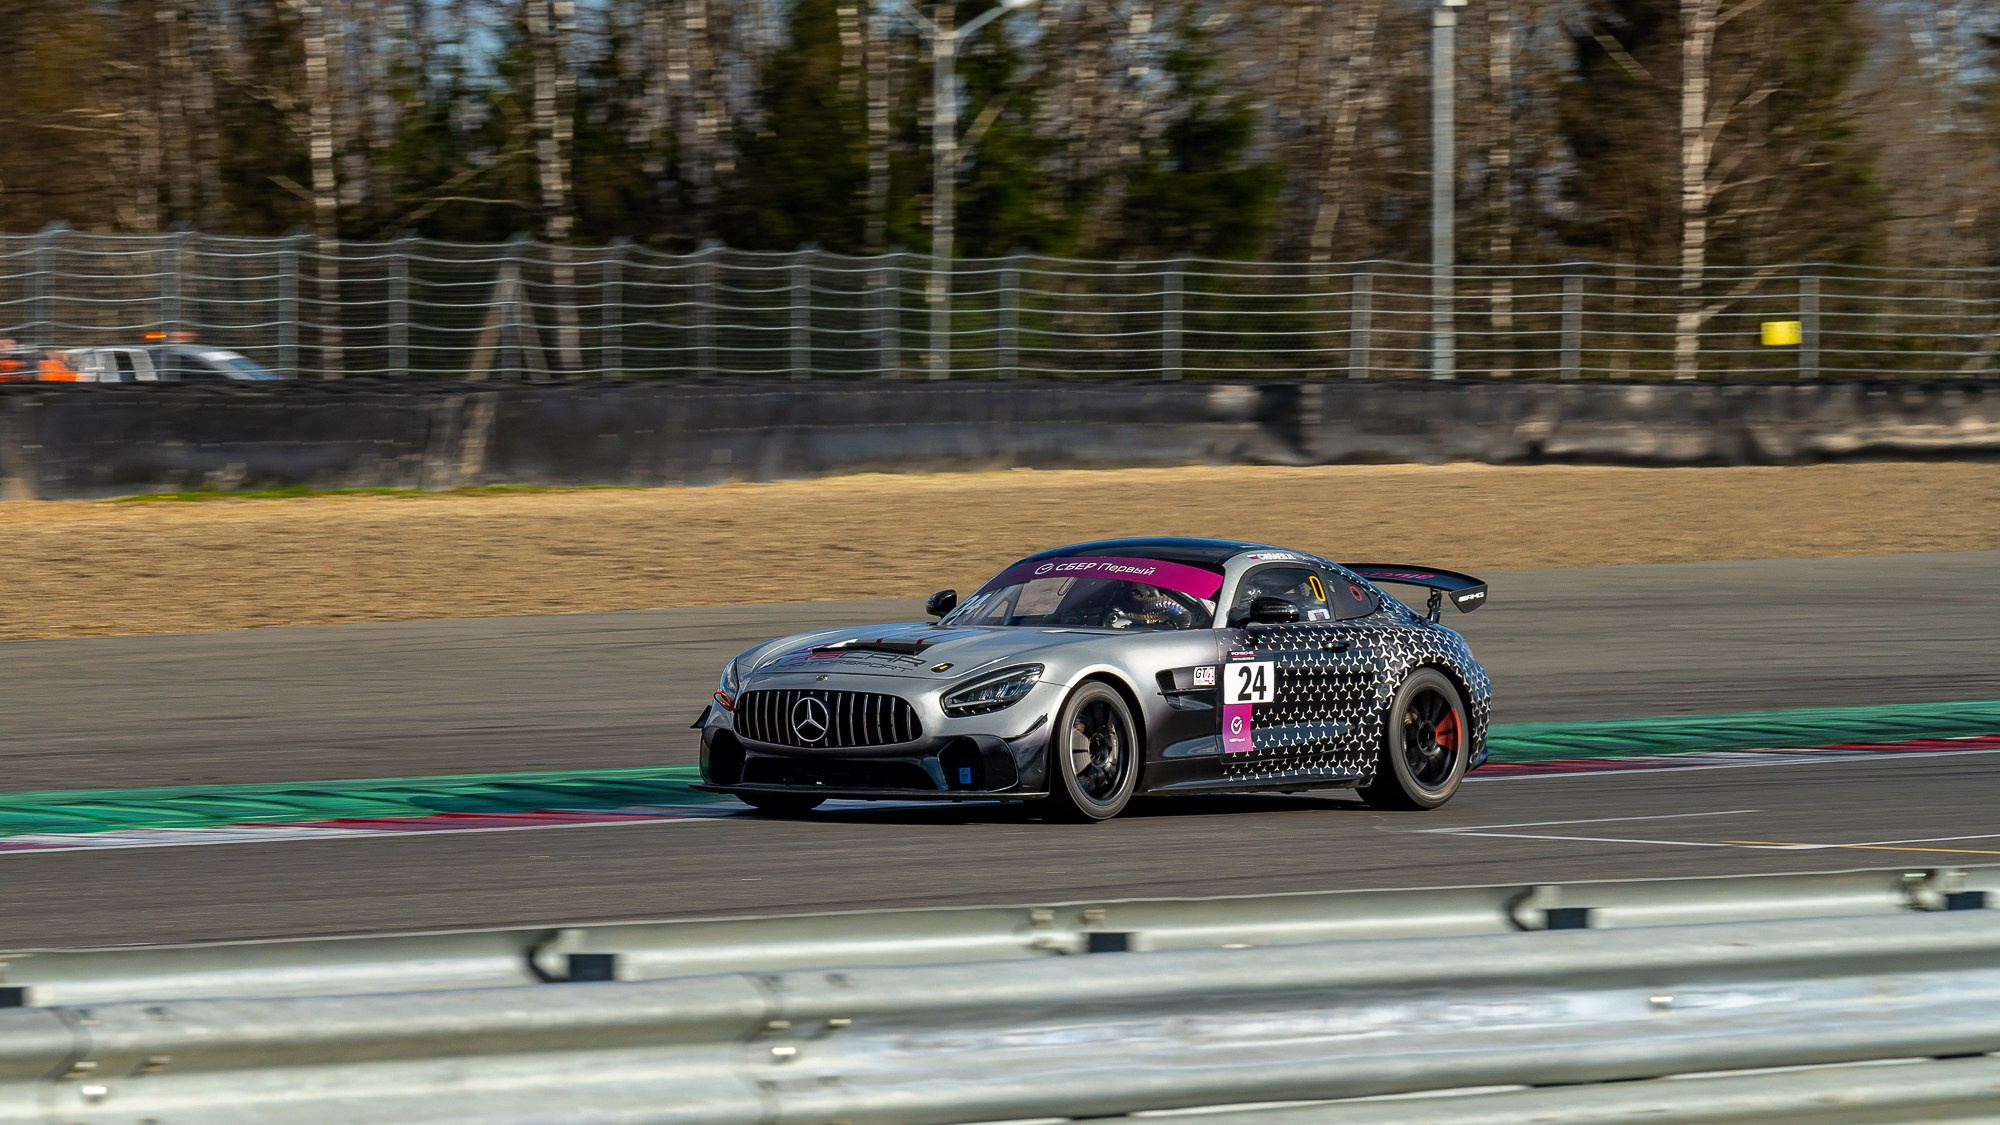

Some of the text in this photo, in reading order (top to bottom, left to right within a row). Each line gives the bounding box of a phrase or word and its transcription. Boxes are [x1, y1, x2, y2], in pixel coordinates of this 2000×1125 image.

[1055, 562, 1156, 576] СБЕР Первый
[1237, 665, 1267, 701] 24
